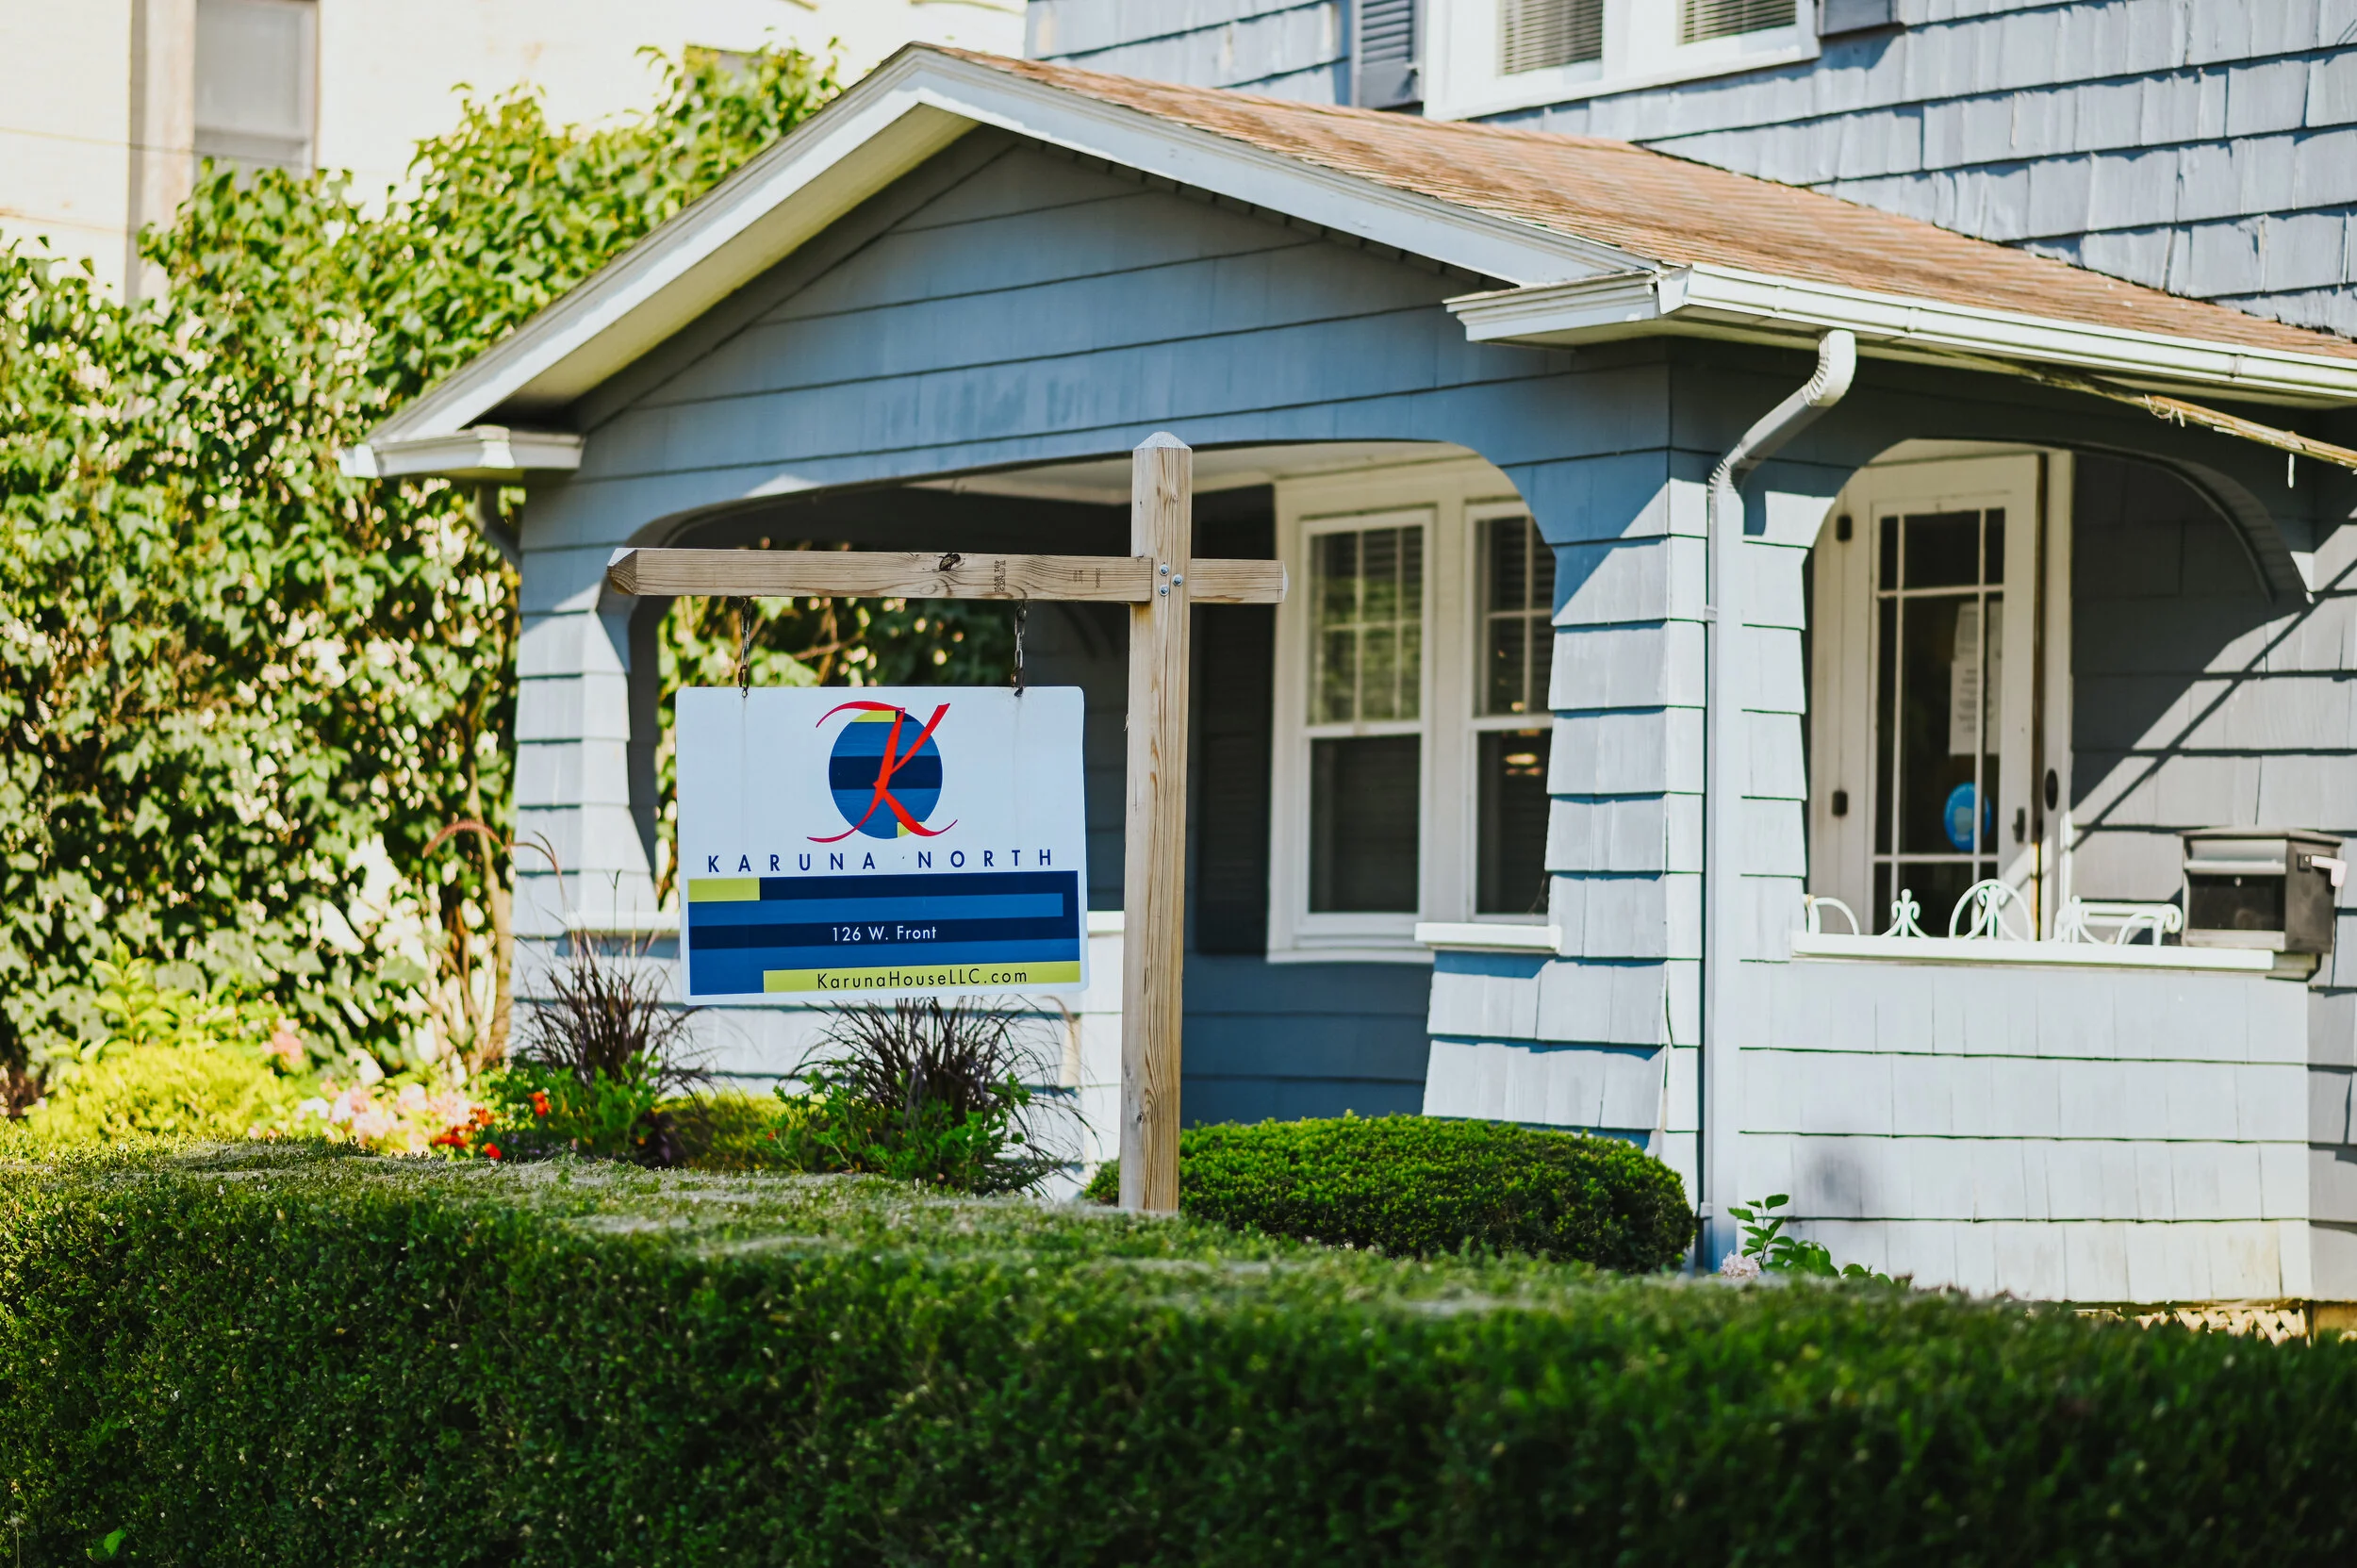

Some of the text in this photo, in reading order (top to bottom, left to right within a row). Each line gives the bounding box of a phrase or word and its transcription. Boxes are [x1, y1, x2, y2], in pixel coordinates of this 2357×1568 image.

[807, 701, 958, 843] K
[707, 849, 1051, 873] KARUNA NORTH
[832, 925, 937, 942] 126 W. Front
[817, 967, 1028, 989] KarunaHouseLLC.com
